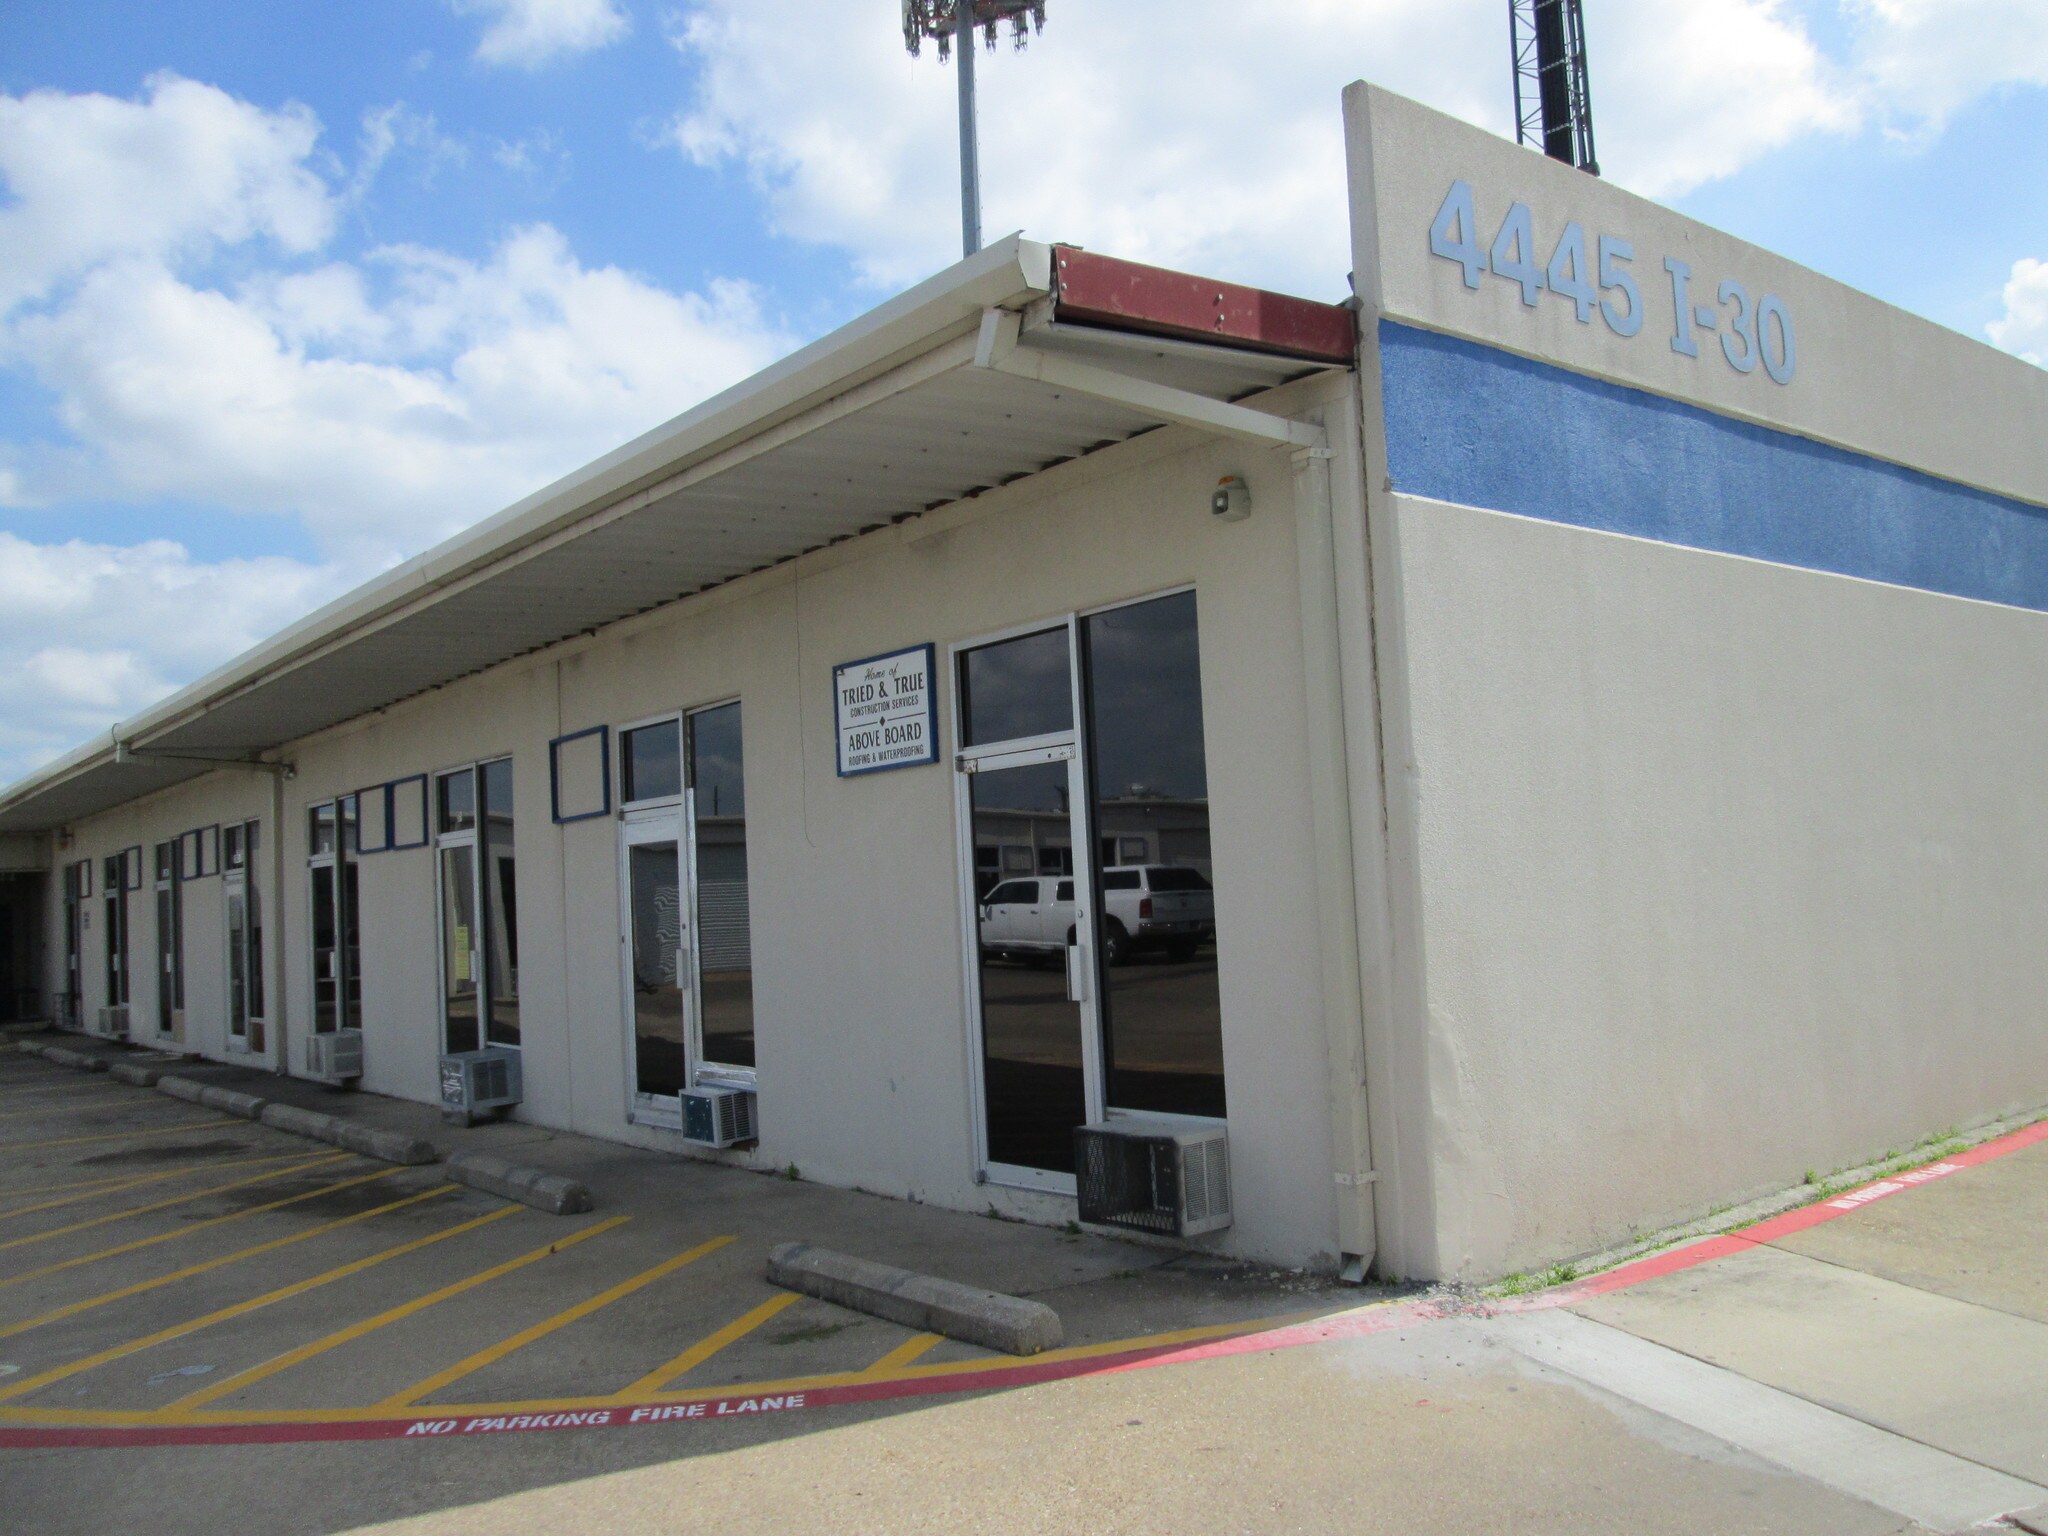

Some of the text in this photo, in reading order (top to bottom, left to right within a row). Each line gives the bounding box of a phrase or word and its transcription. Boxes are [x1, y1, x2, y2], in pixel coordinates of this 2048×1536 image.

[1429, 180, 1796, 385] 4445 I-30
[864, 662, 899, 681] Home of
[842, 672, 925, 706] TRIED & TRUE
[850, 694, 919, 718] CONSTRUCTION SERVICES
[848, 722, 922, 752] ABOVE BOARD
[848, 753, 871, 767] ROOFING
[878, 744, 924, 761] WATERPROOFING
[405, 1394, 806, 1436] NO PARKING FIRE LANE
